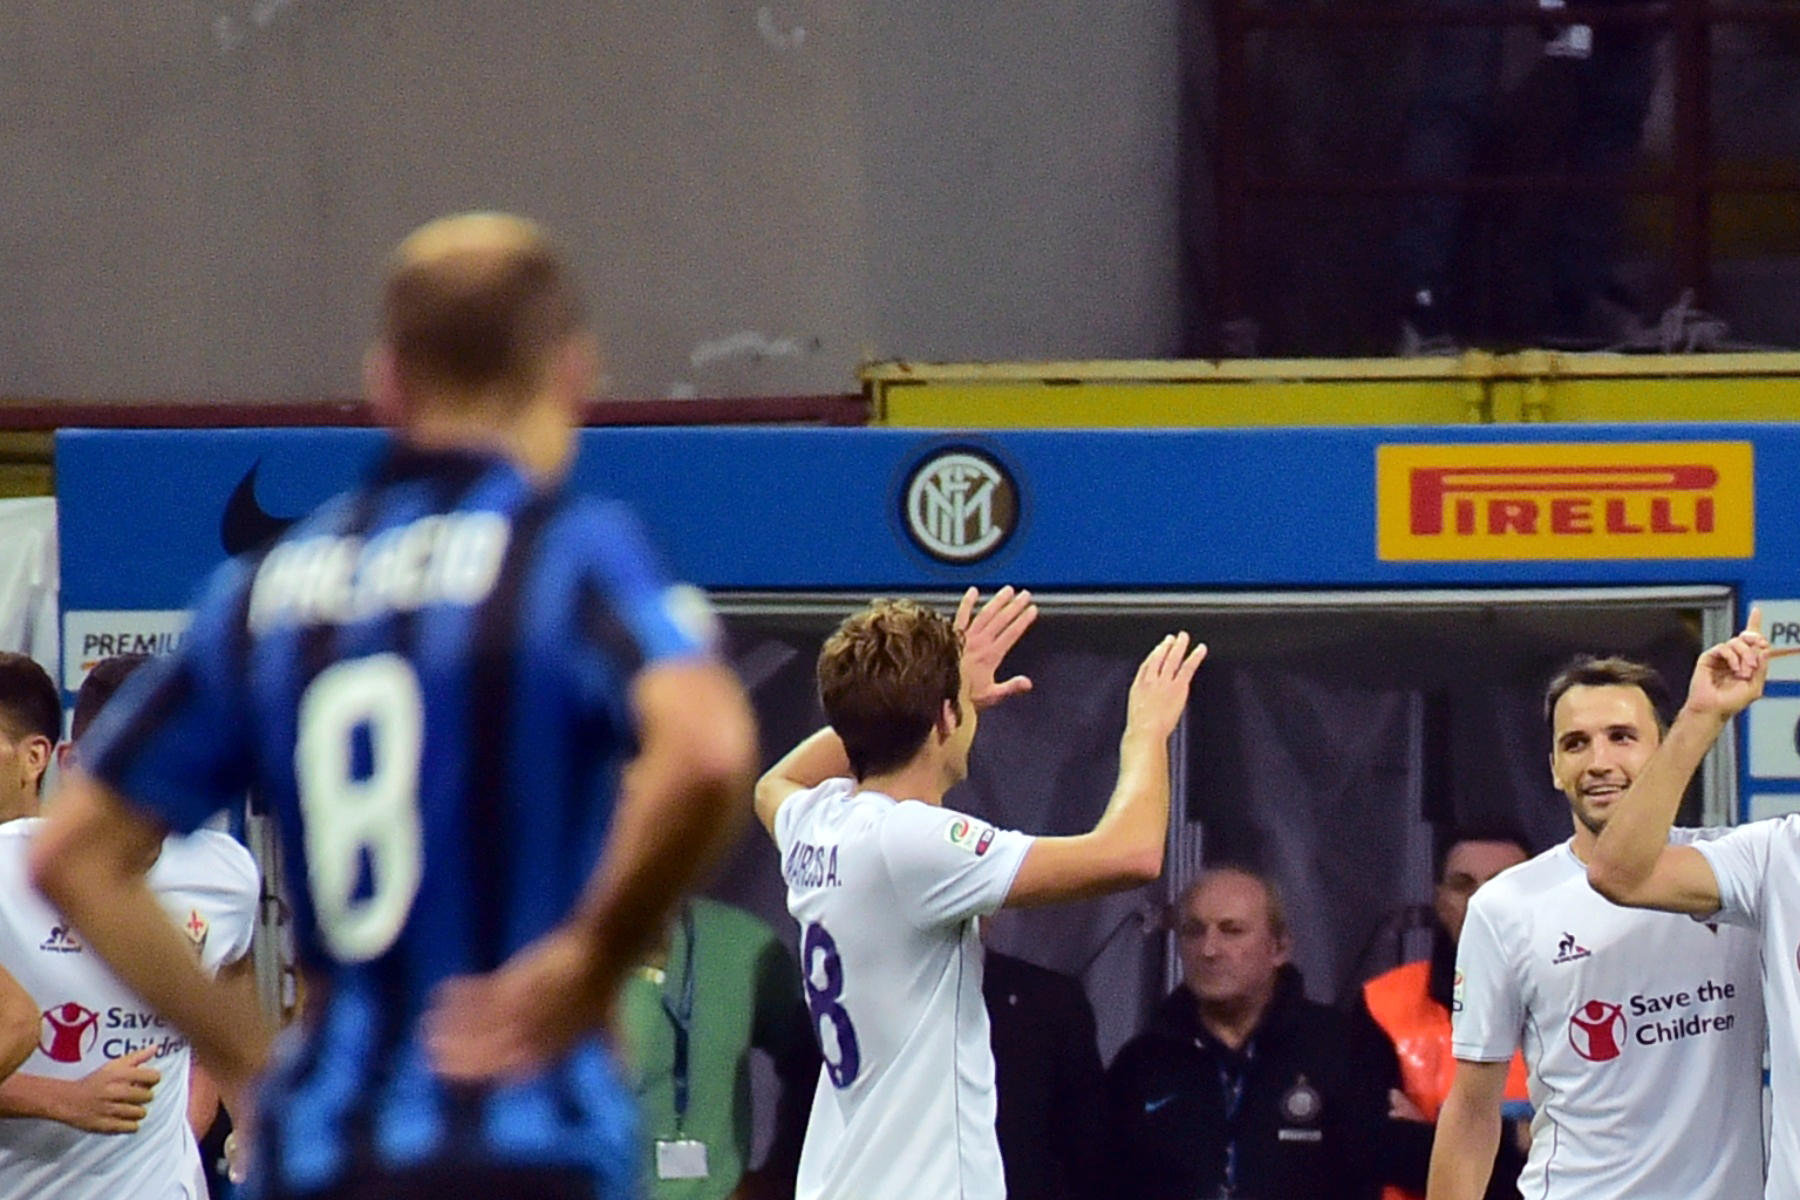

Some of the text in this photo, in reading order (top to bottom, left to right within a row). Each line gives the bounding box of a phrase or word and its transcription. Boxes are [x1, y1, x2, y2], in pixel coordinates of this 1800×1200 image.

[1410, 465, 1719, 535] PIRELLI
[297, 652, 425, 963] 8
[804, 921, 860, 1090] 8
[1630, 980, 1736, 1017] Save the
[1635, 1014, 1735, 1045] Children
